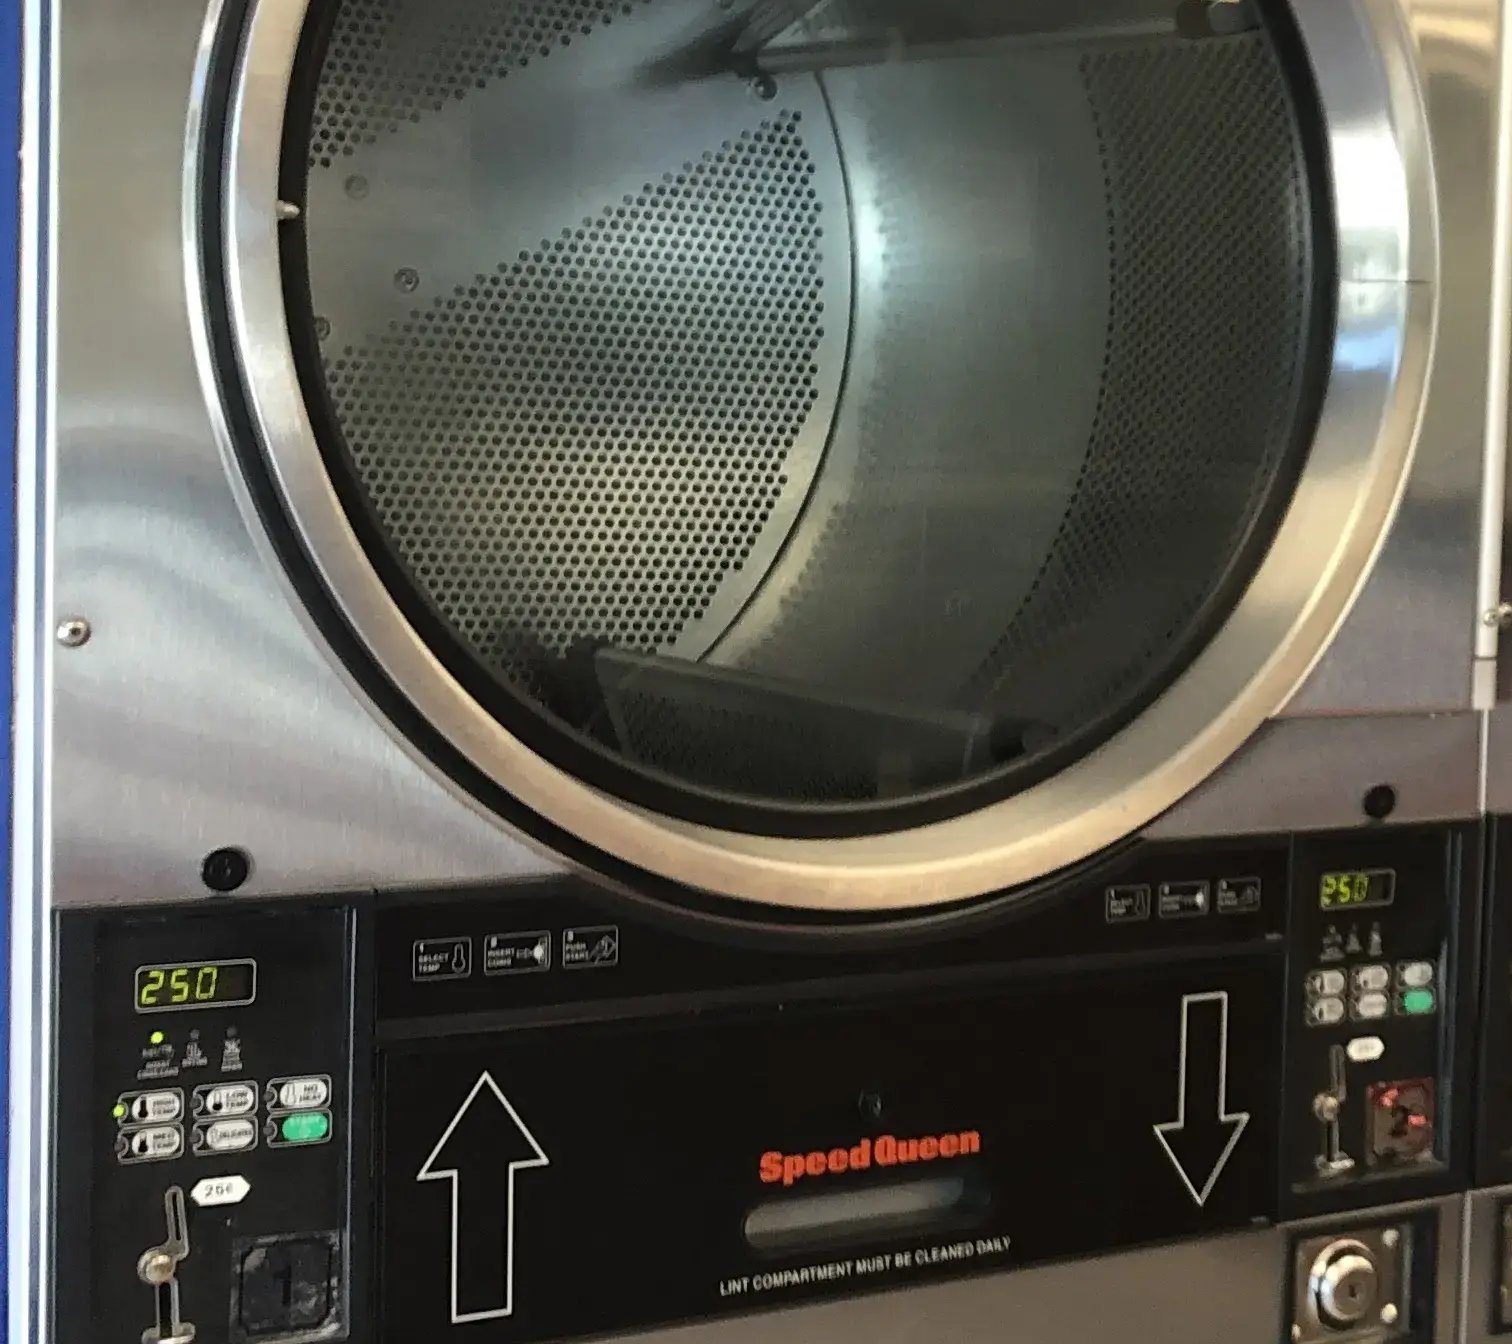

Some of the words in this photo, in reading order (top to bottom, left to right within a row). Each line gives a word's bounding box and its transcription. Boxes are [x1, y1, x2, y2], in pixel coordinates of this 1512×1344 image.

[141, 966, 217, 1004] 250
[759, 1137, 871, 1187] Speed
[874, 1130, 981, 1167] Queen
[719, 1276, 750, 1297] LINT
[752, 1260, 854, 1292] COMPARTMENT
[855, 1253, 892, 1275] MUST
[895, 1251, 913, 1269] BE
[914, 1239, 975, 1266] CLEANED
